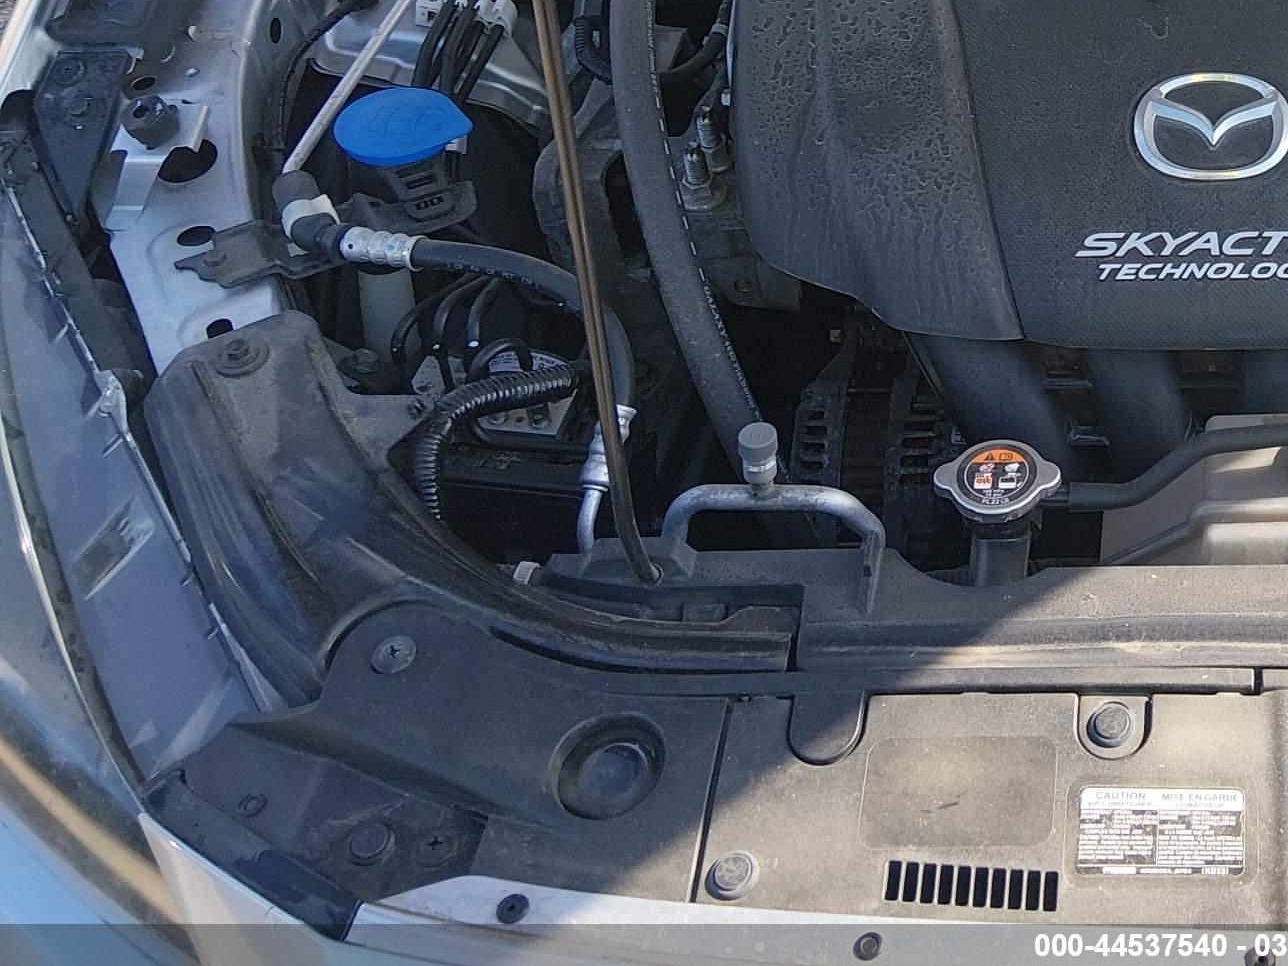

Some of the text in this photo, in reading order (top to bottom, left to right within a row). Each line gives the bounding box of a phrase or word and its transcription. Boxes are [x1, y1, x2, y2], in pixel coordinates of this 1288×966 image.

[1096, 791, 1146, 801] CAUTION
[1161, 792, 1239, 802] MISE EN GARDE
